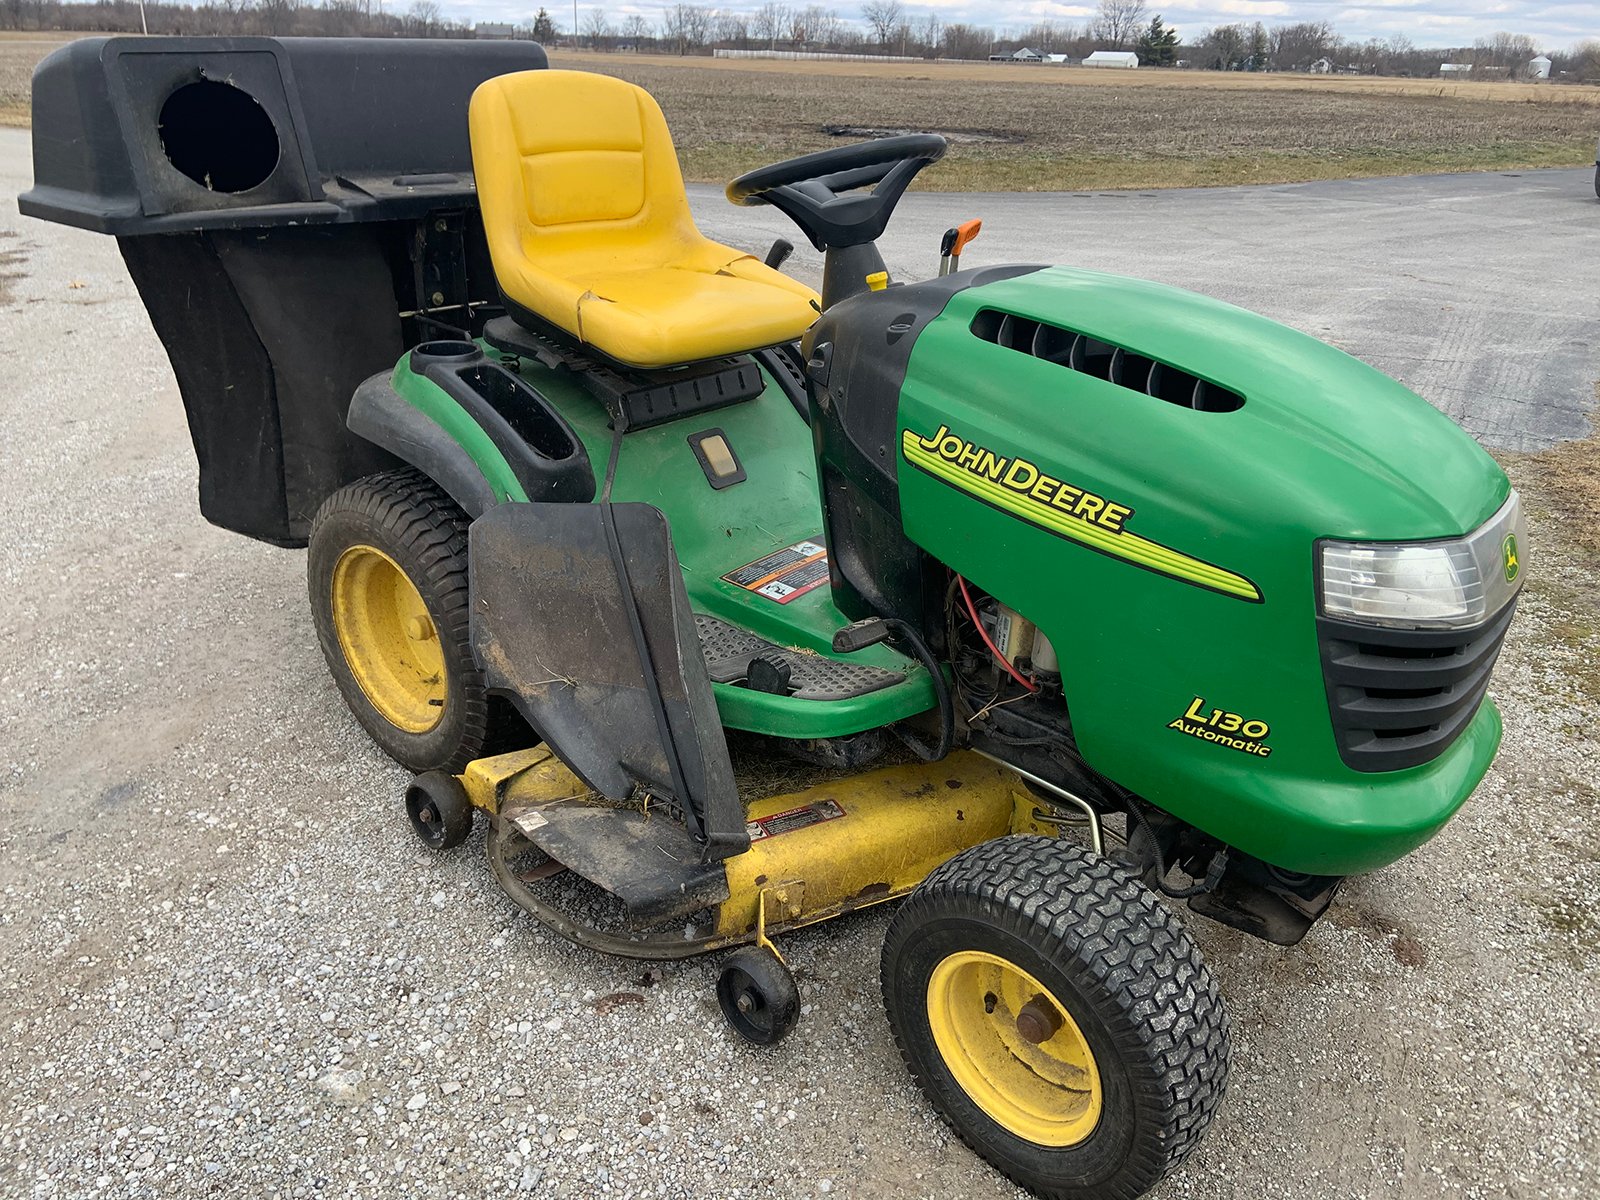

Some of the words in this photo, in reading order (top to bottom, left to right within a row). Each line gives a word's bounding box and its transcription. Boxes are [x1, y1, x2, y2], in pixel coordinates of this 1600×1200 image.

[919, 425, 1006, 480] JOHN
[1000, 458, 1132, 531] DEERE
[1168, 718, 1271, 757] Automatic
[1184, 697, 1269, 738] L130
[777, 808, 803, 819] DANGER
